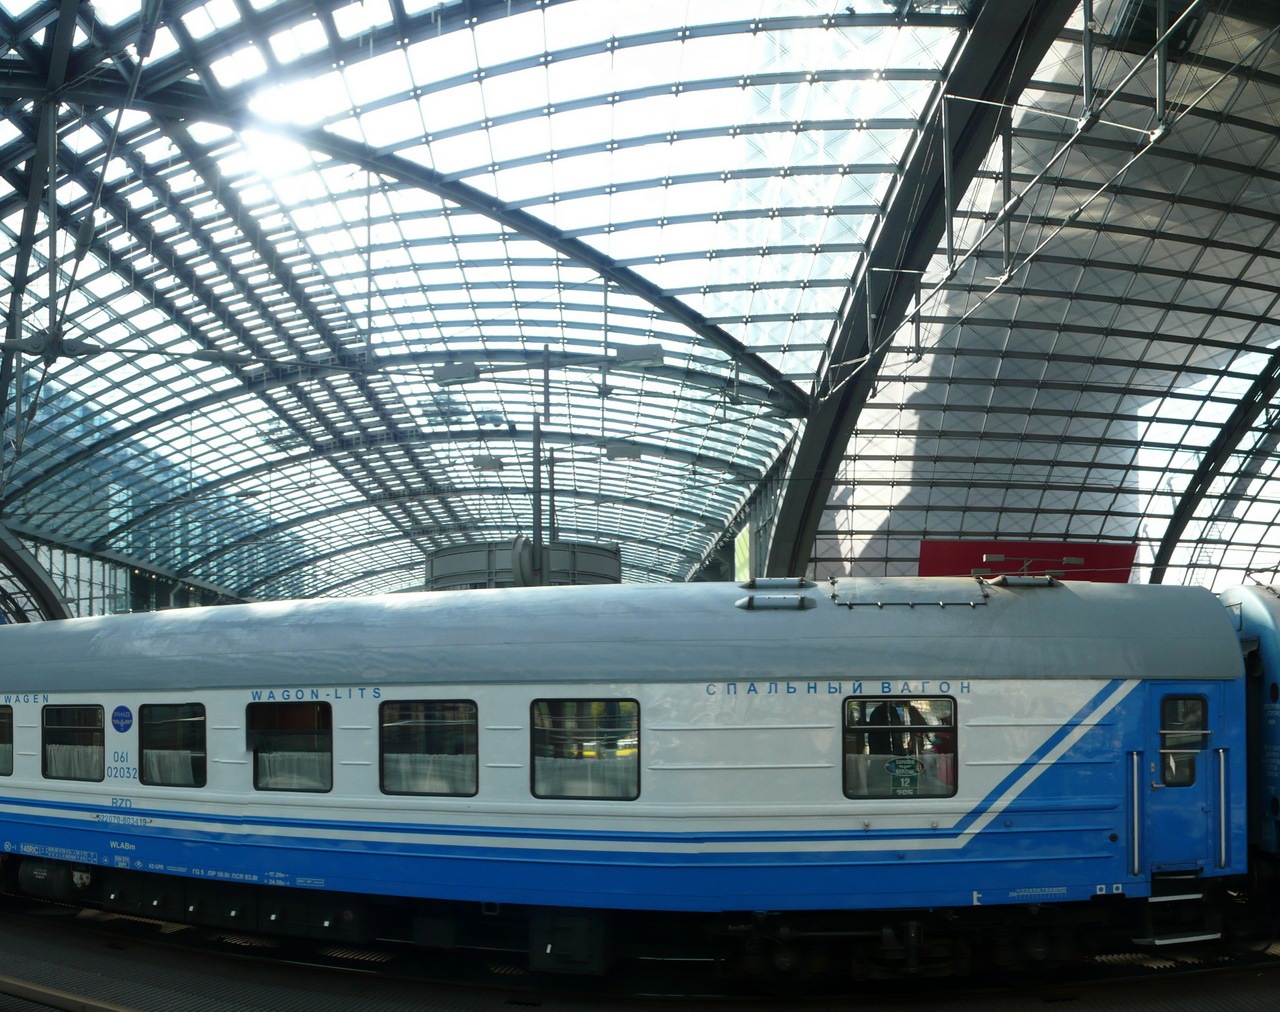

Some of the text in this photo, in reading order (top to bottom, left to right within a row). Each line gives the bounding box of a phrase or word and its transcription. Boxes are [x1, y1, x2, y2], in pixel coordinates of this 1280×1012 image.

[251, 688, 382, 701] WAGON-LITS
[705, 680, 971, 696] СПАЛЬНЫЙ ВАГОН
[113, 751, 129, 764] 061
[107, 766, 138, 779] 02032
[900, 777, 910, 787] 12
[111, 797, 132, 808] RZD
[109, 840, 136, 851] WLABm
